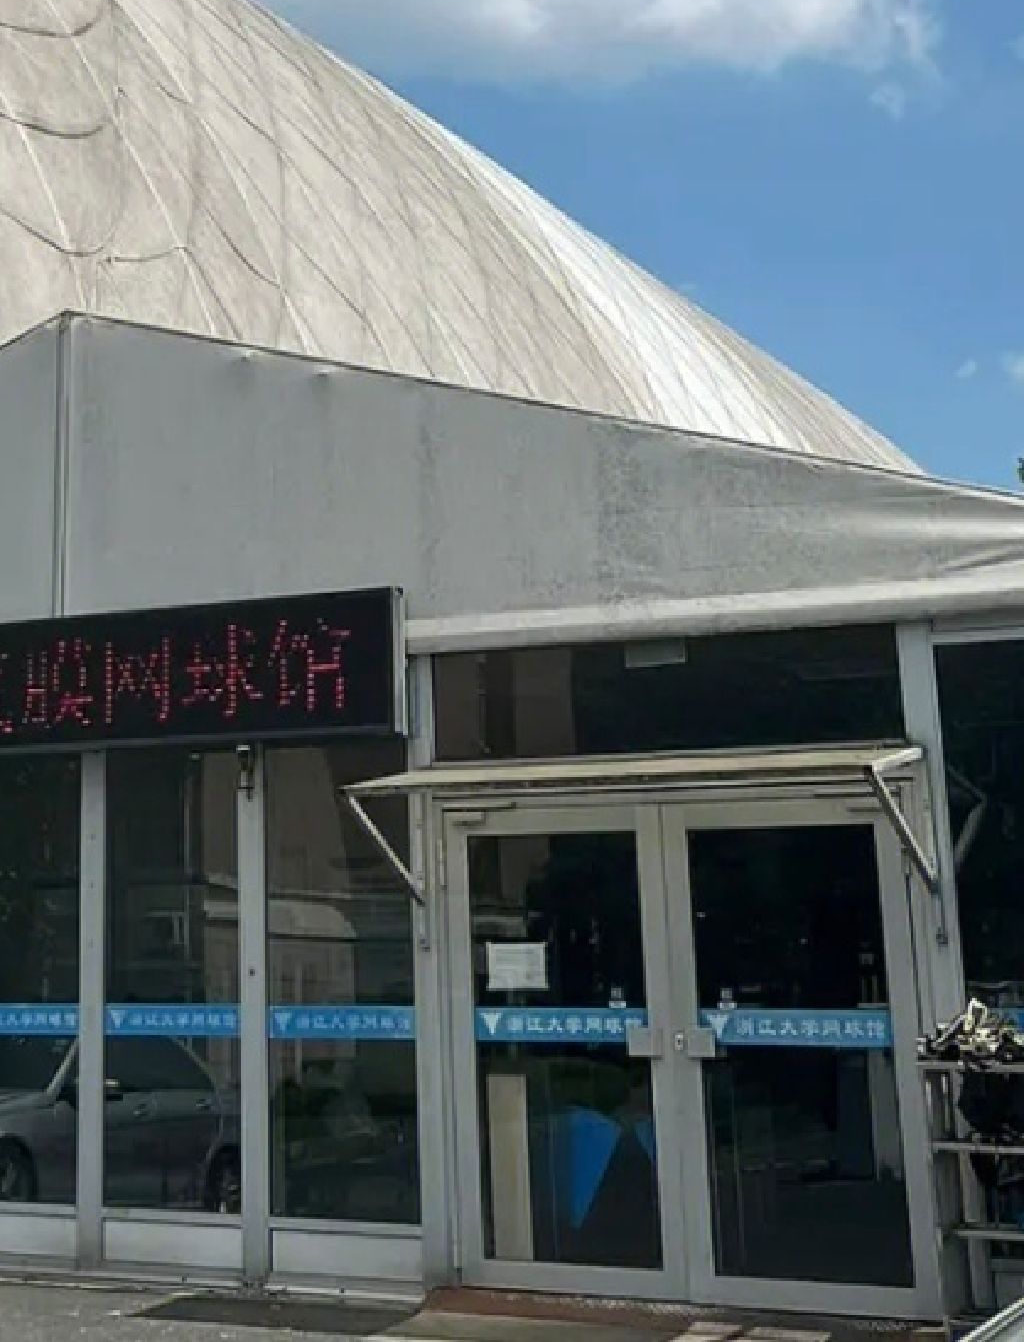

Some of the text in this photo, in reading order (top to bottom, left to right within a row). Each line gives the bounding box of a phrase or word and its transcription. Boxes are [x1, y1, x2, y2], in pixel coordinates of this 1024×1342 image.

[735, 1017, 887, 1040] 浙江大学网球馆
